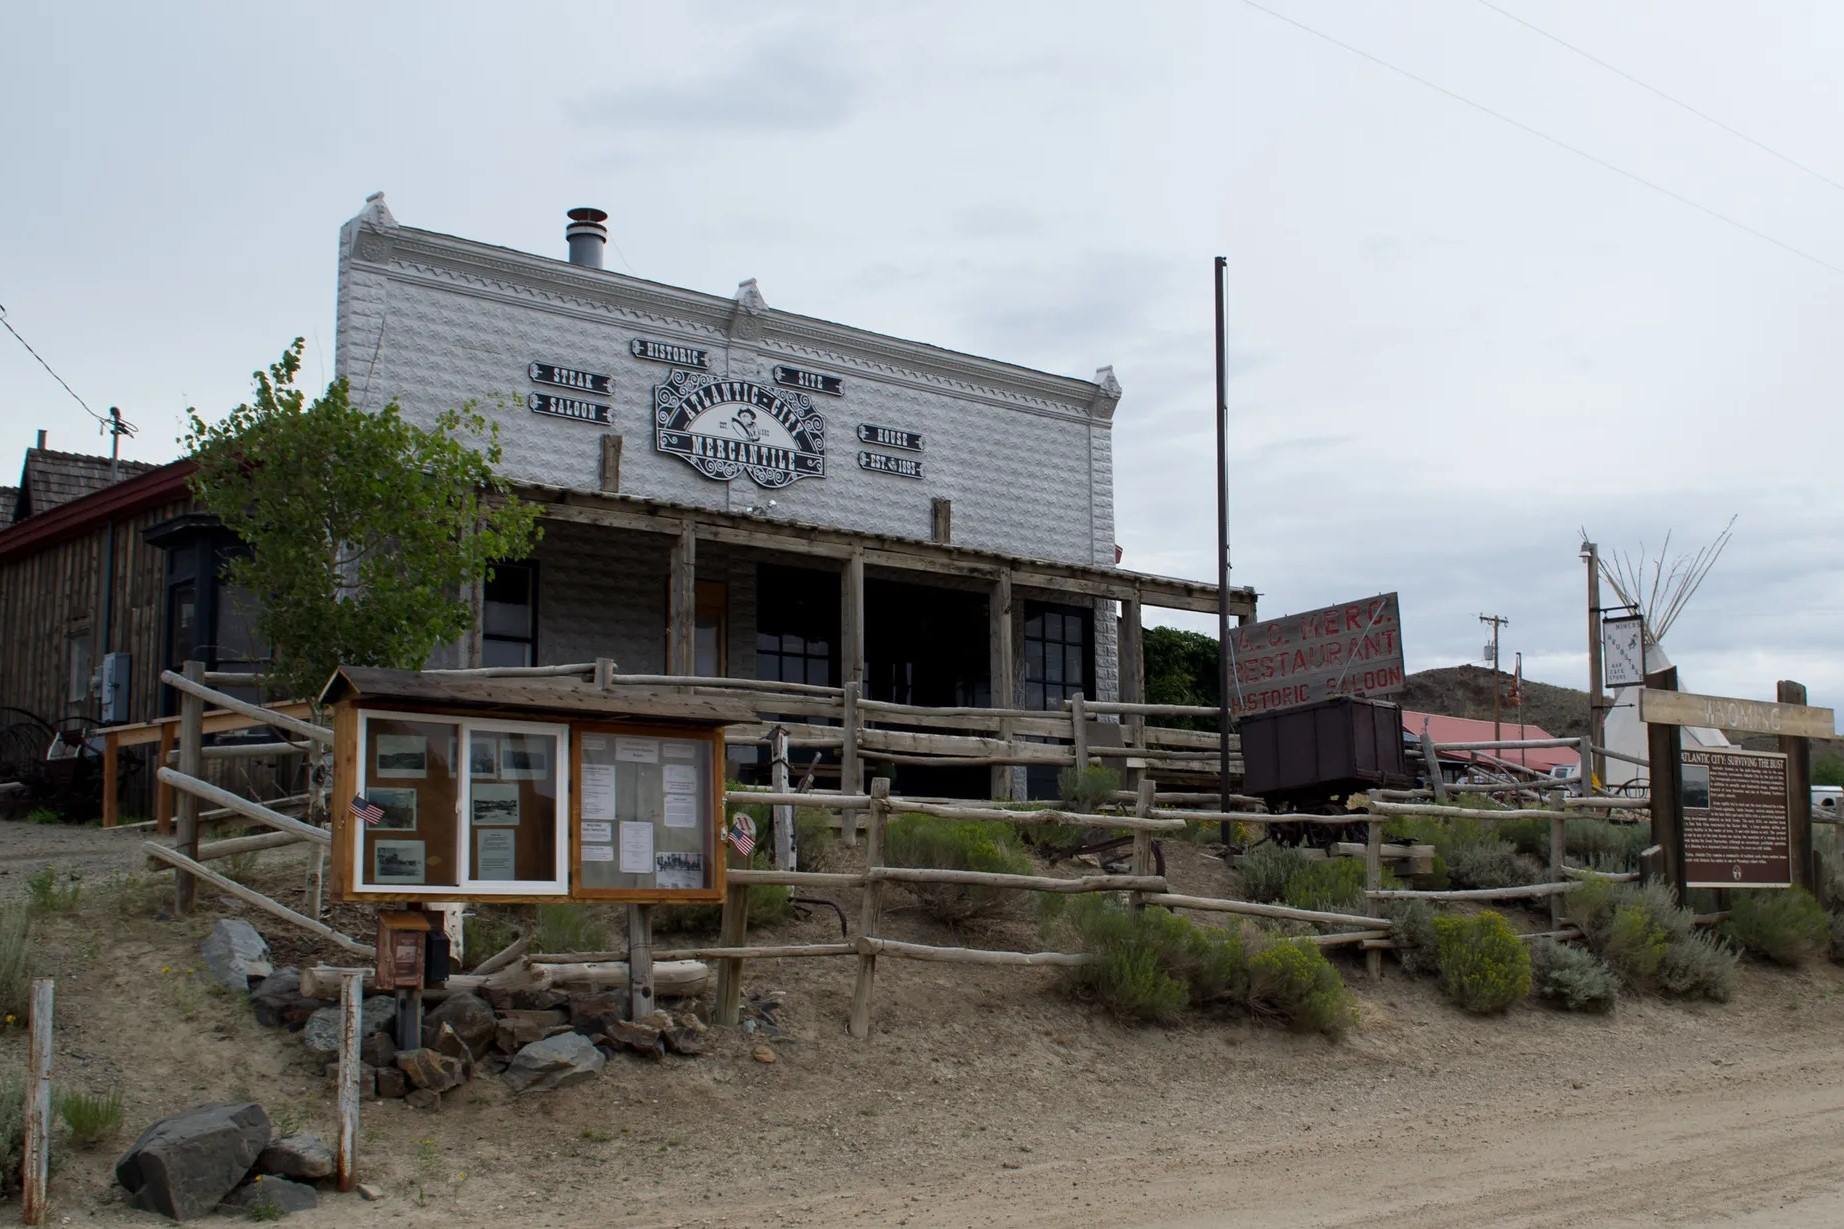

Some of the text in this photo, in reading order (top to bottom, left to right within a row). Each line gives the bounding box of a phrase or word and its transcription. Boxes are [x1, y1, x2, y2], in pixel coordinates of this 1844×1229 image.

[646, 341, 699, 365] HISTORIC
[553, 367, 593, 389] STEAK
[798, 371, 823, 389] SITE
[549, 397, 597, 420] SALOON
[681, 382, 805, 437] ATLANTIC CITY
[877, 428, 908, 447] HOUSE
[691, 435, 796, 471] MERCANTILE
[870, 454, 916, 475] EST. 1893
[1232, 629, 1397, 684] RESTAURANT
[1231, 664, 1402, 714] HISTORIC SALOON
[1703, 699, 1780, 730] WYOMING
[1727, 756, 1758, 768] SURVIVING
[1758, 758, 1770, 769] THE
[1770, 759, 1784, 769] BUST
